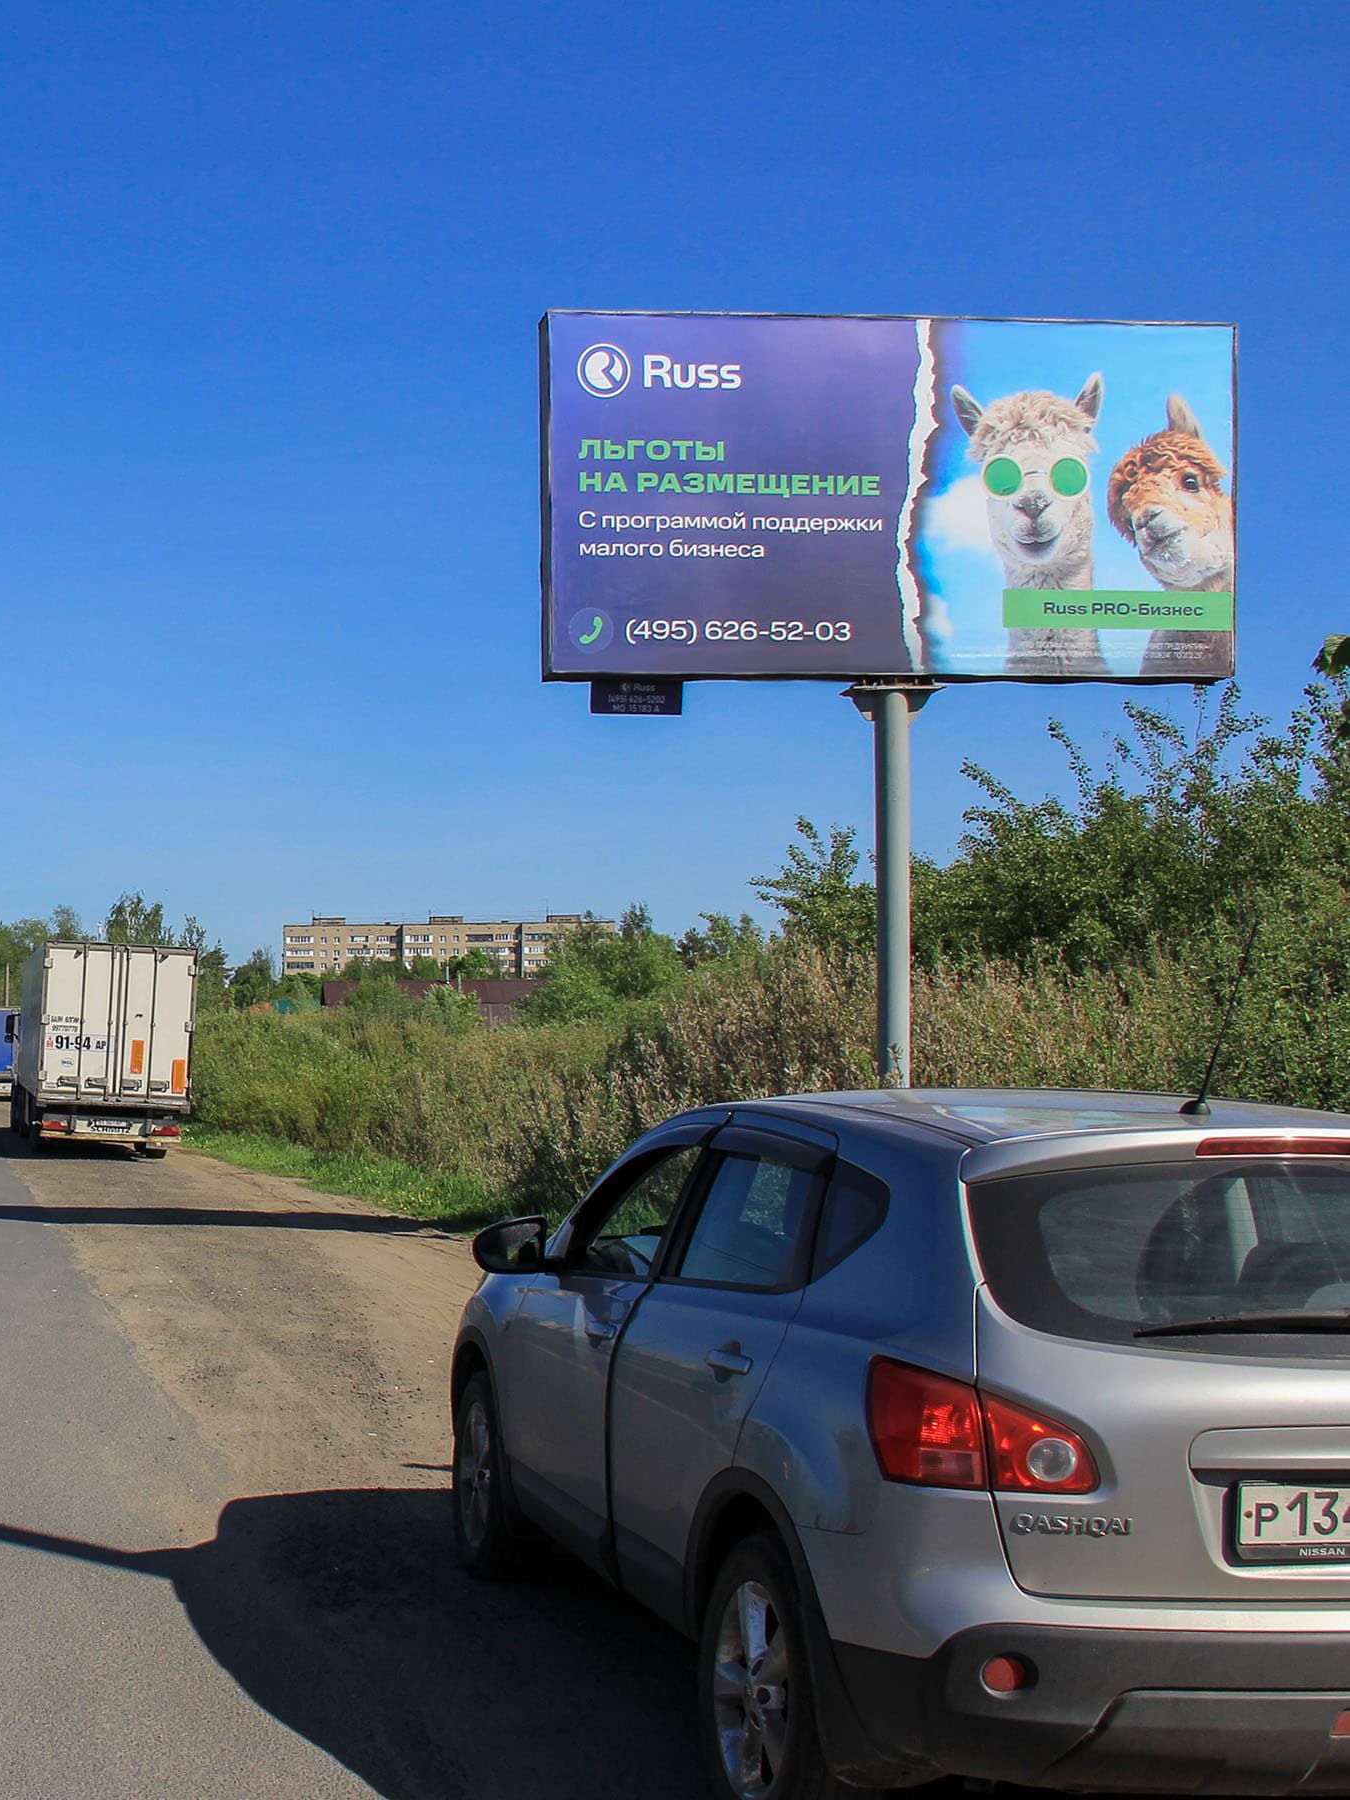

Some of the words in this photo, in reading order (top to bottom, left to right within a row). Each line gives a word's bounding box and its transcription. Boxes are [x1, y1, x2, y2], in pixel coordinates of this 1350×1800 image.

[642, 354, 742, 390] Russ
[578, 438, 725, 462] ЛЬГОТЫ
[578, 471, 628, 493] НА
[636, 472, 881, 499] РАЗМЕЩЕНИЕ
[578, 511, 597, 530] С
[601, 510, 747, 533] программой
[752, 514, 883, 534] поддержки
[578, 541, 664, 558] малого
[669, 538, 766, 559] бизнеса
[1042, 601, 1088, 617] Russ
[1091, 601, 1205, 618] PRO-Бизнес
[624, 618, 699, 645] (495)
[704, 619, 852, 642] 626-52-03
[54, 1034, 92, 1050] 91-94
[1011, 1512, 1133, 1538] QASHQAI
[1299, 1547, 1346, 1557] NISSAN
